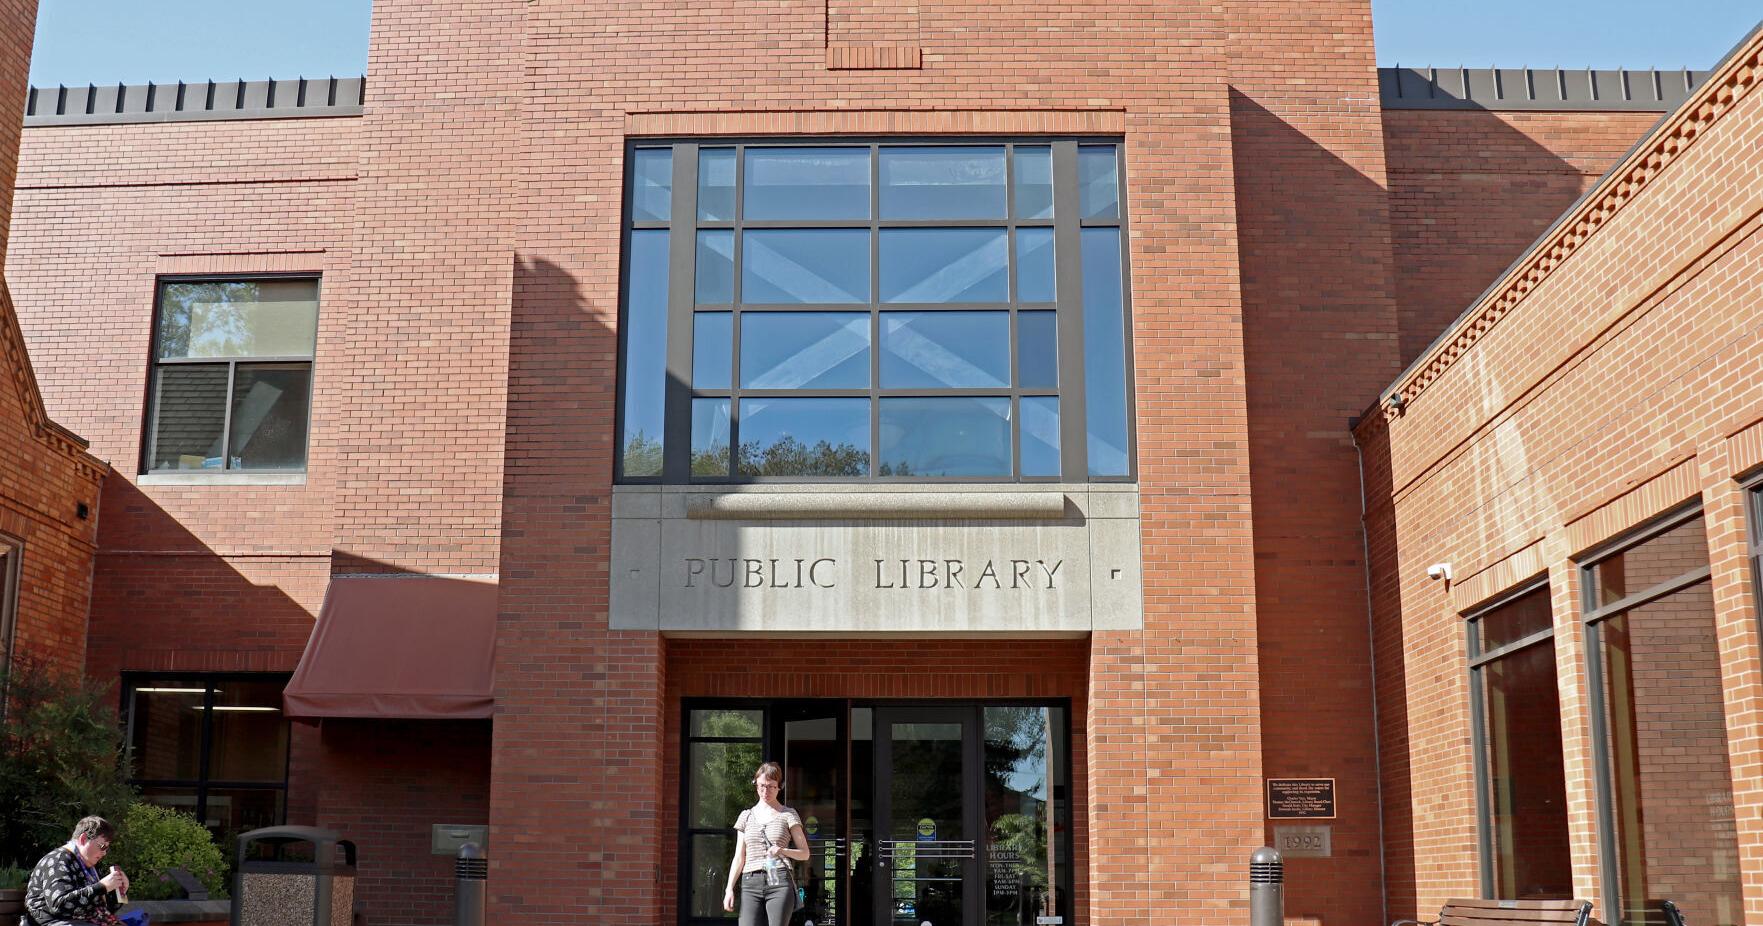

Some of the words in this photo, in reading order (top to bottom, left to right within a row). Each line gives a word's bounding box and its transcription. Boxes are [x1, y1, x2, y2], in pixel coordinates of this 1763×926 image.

[684, 558, 836, 588] PUBLIC
[874, 559, 1064, 589] LIBRARY
[1285, 835, 1321, 849] 1992
[990, 852, 1020, 860] HOURS
